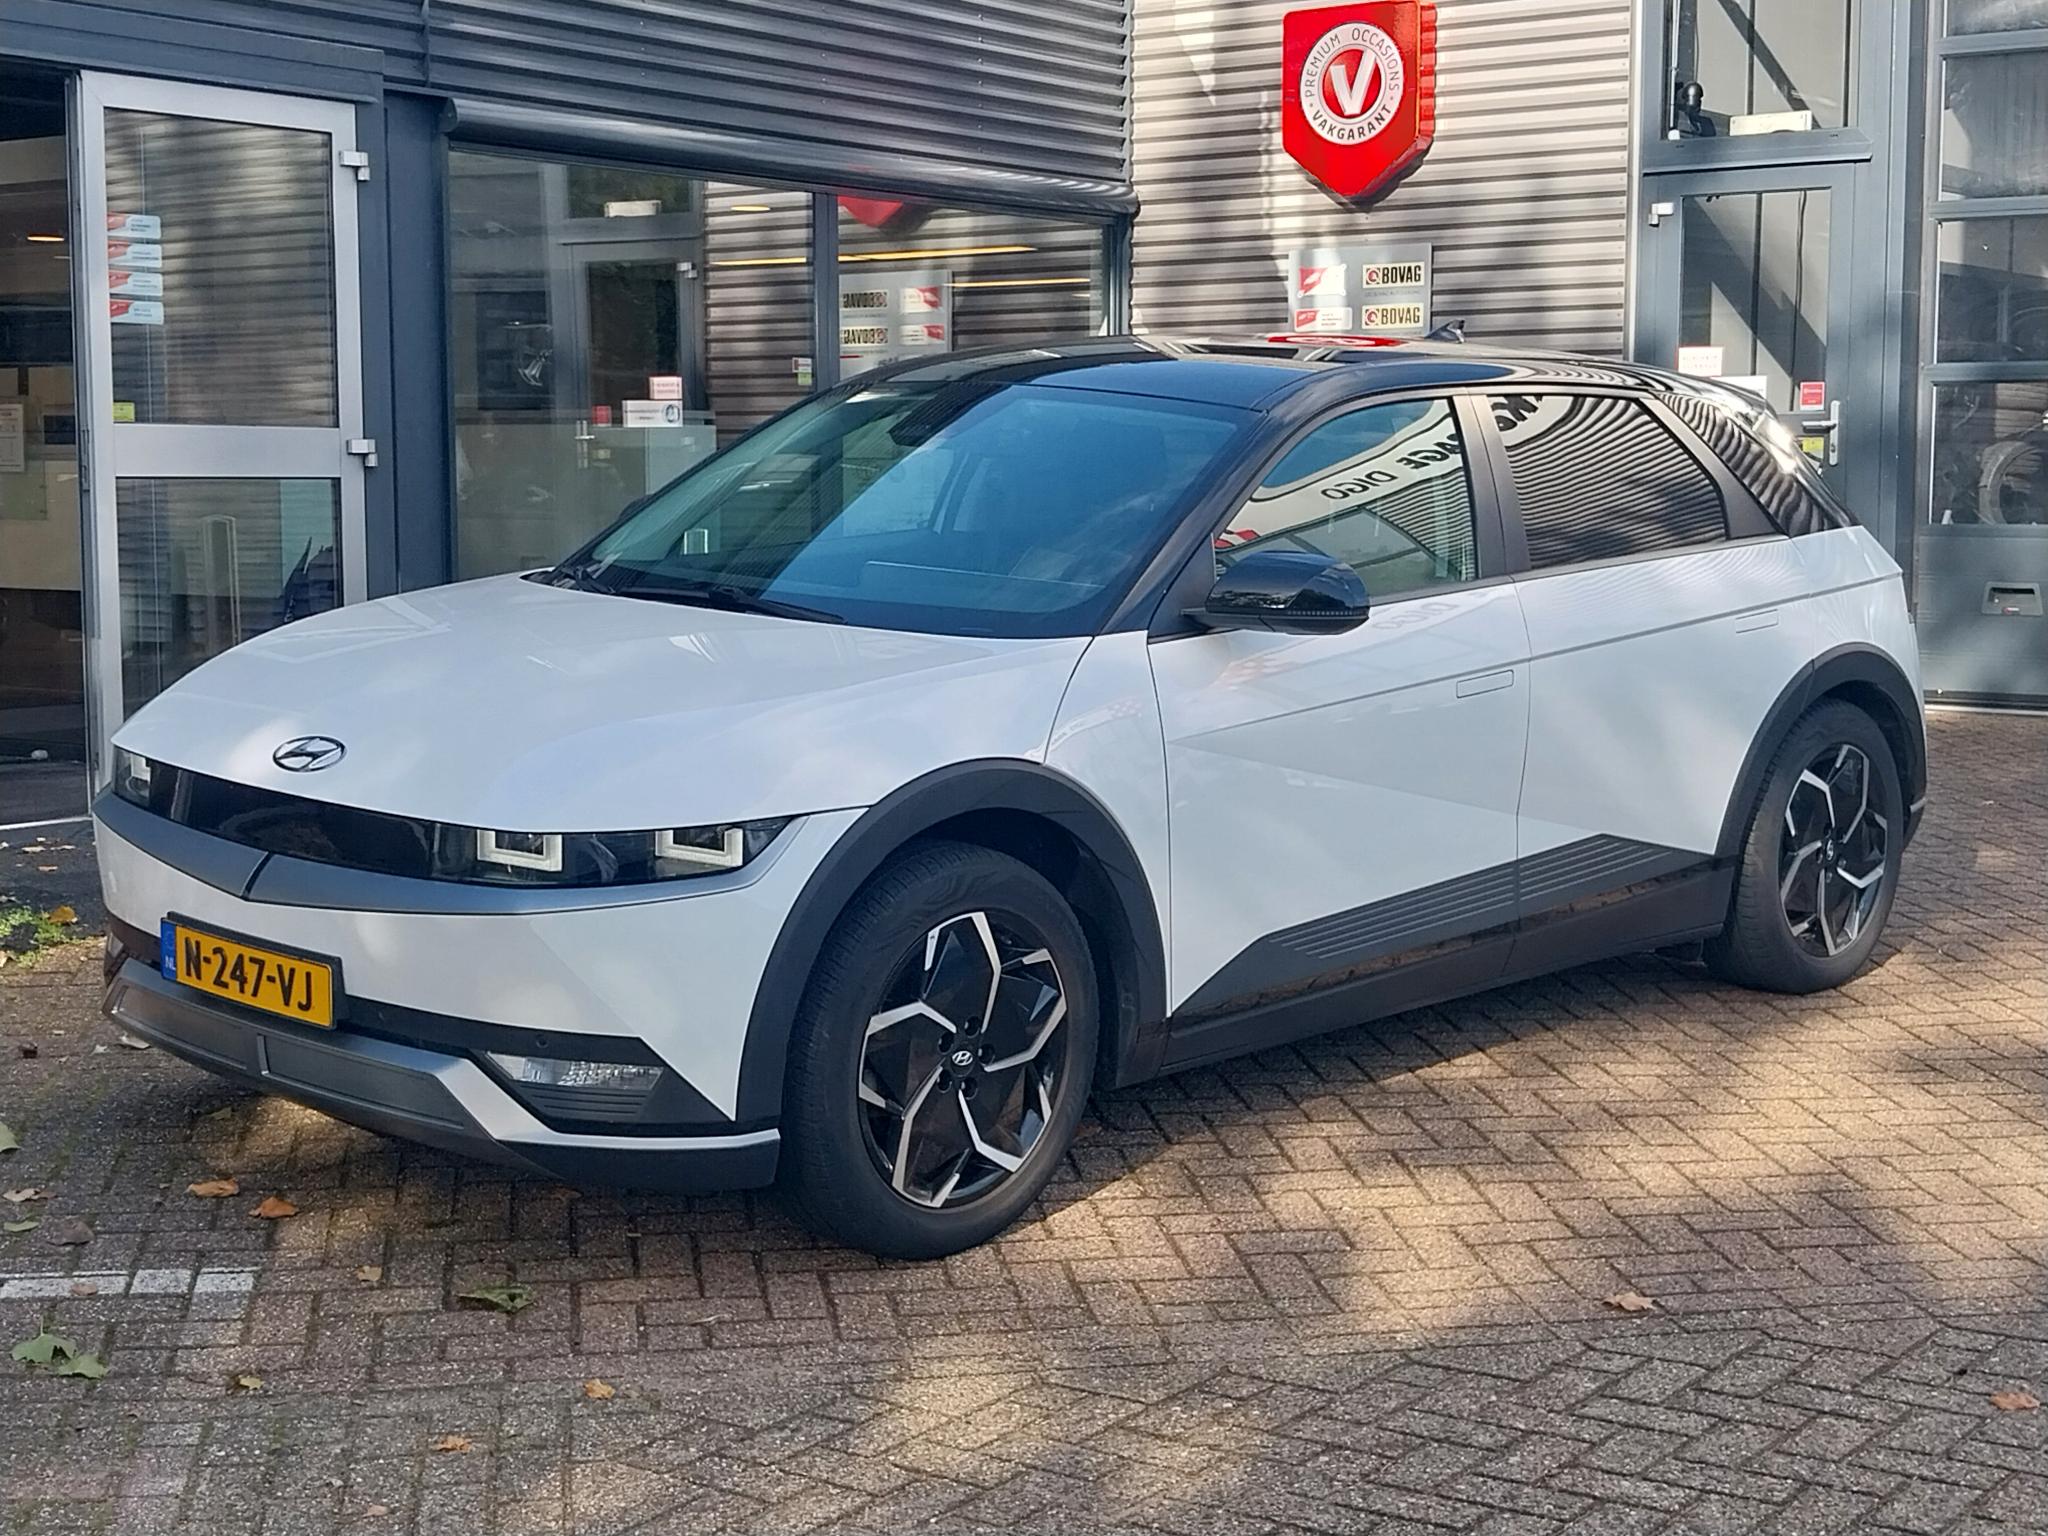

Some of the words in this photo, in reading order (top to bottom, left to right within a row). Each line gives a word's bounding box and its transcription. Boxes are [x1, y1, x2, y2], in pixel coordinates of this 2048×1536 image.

[1304, 33, 1341, 98] PREMIUM
[1351, 27, 1400, 91] OCCASIONS
[1312, 104, 1392, 140] VAKGARANT
[1381, 265, 1422, 284] BOVAG
[1380, 306, 1420, 325] BOVAG
[165, 957, 176, 971] NL
[184, 936, 312, 1012] N-247-VJ
